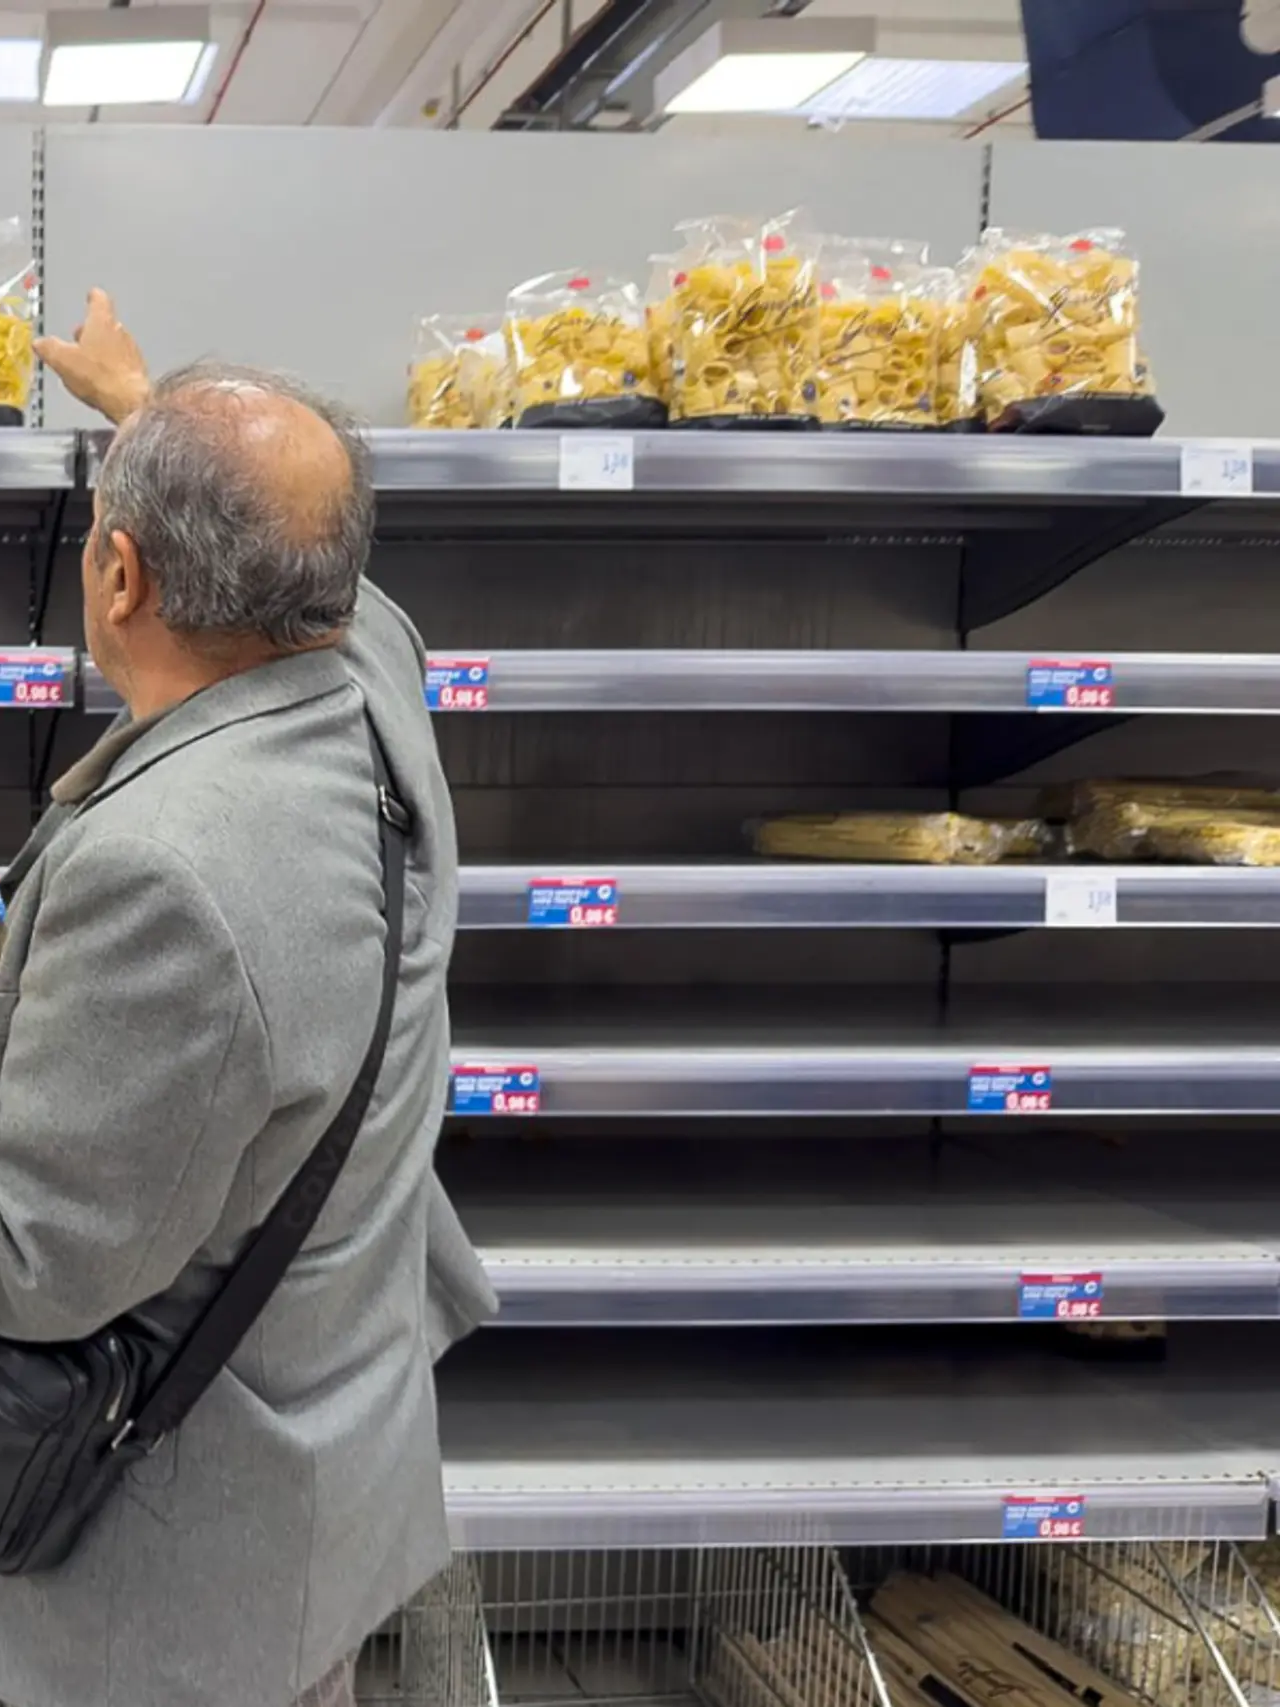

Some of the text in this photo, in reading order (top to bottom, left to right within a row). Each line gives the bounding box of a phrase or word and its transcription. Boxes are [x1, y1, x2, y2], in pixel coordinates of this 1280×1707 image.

[50, 686, 60, 699] €
[474, 690, 484, 706] €
[1101, 690, 1110, 703] €
[605, 909, 614, 923] €
[527, 1096, 537, 1109] €
[1039, 1096, 1049, 1108] €
[1090, 1303, 1098, 1316] €
[1072, 1523, 1080, 1535] €
